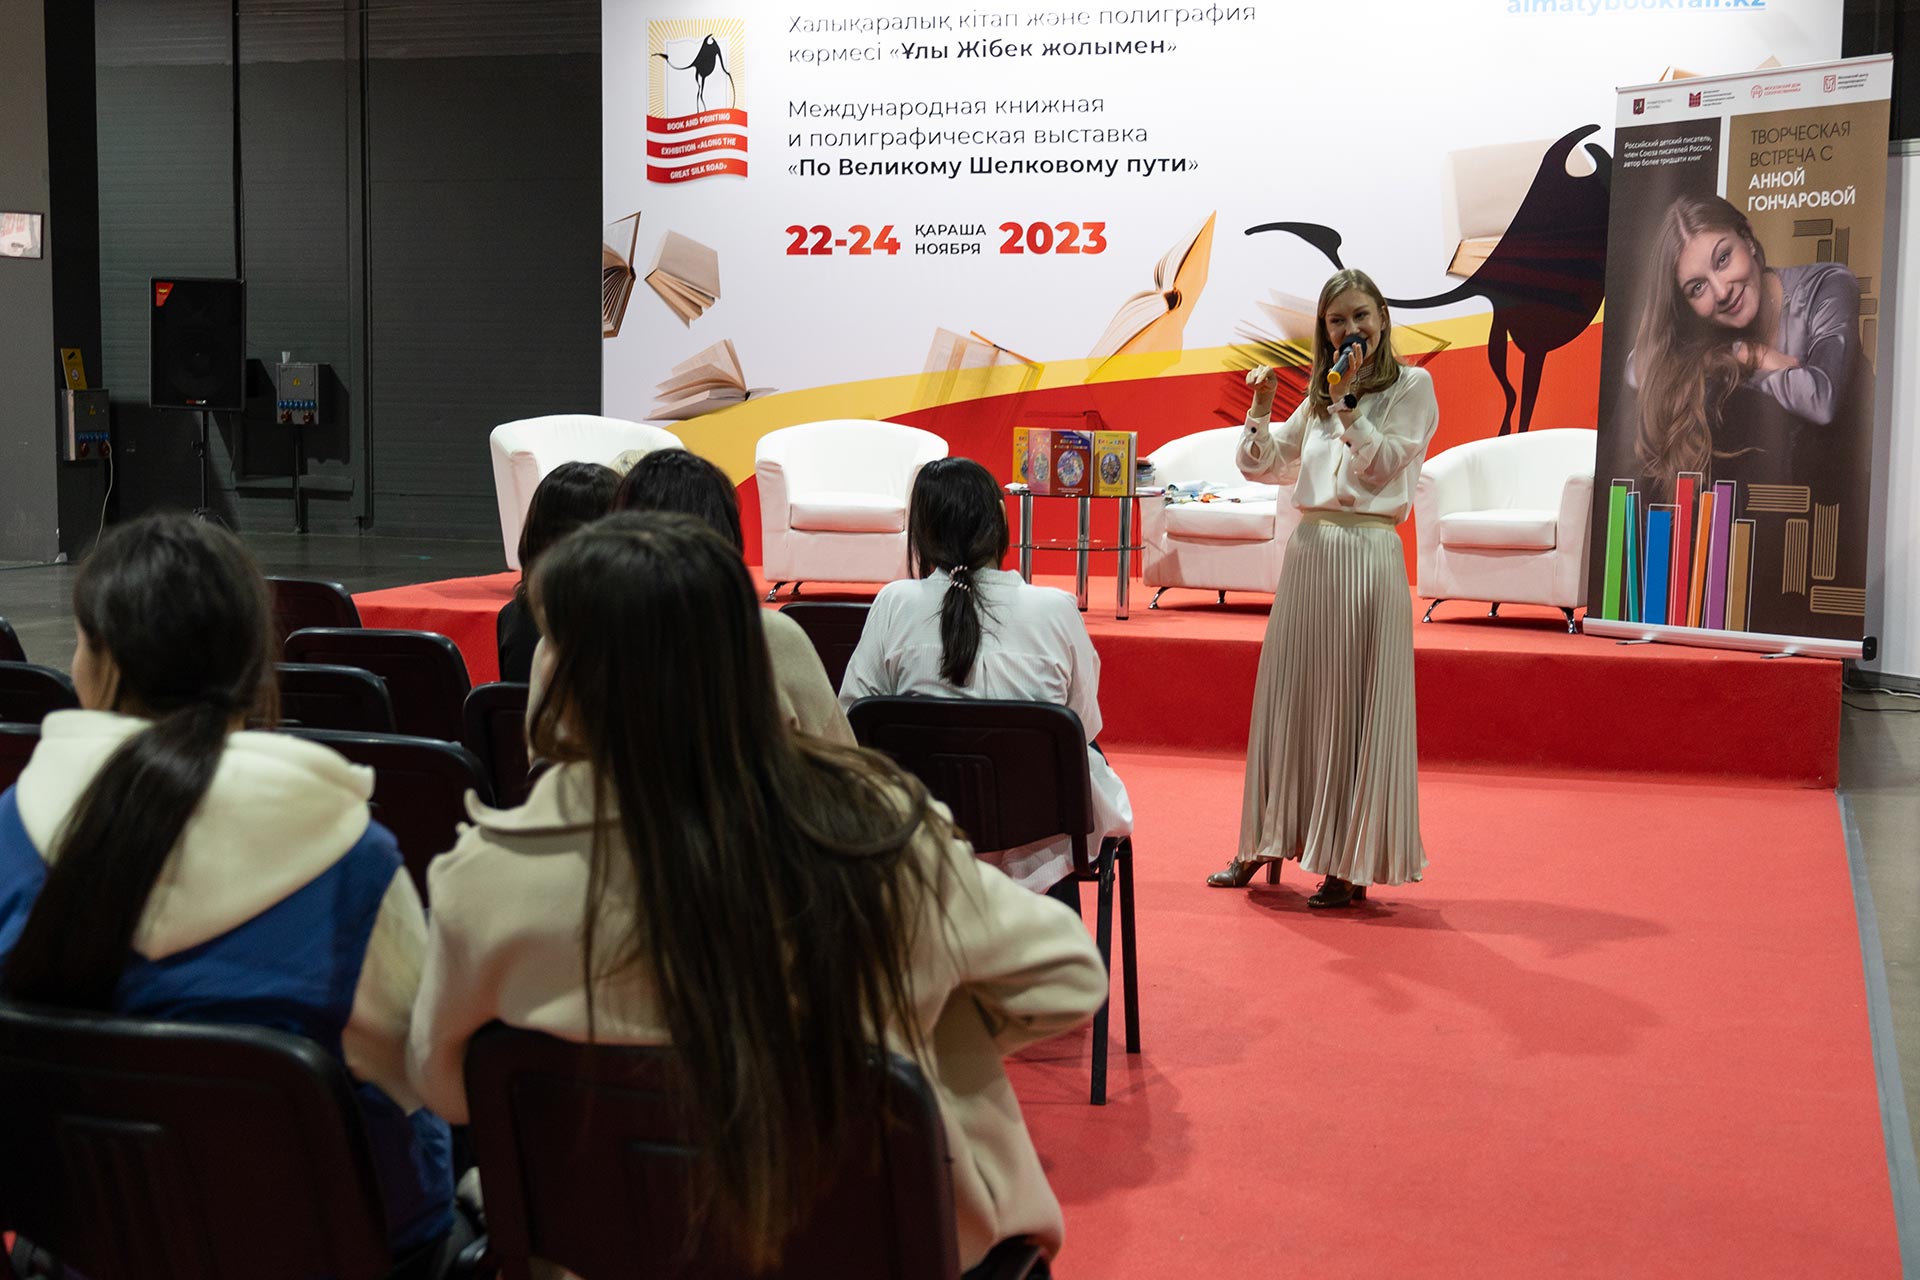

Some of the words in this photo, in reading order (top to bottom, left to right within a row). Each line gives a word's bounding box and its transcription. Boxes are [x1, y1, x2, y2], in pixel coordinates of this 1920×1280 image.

[789, 15, 952, 35] Халықаралық
[959, 9, 1018, 29] кітап
[1027, 11, 1090, 26] және
[1100, 3, 1256, 27] полиграфия
[789, 42, 881, 66] көрмесі
[890, 42, 948, 60] «Ұлы
[957, 38, 1033, 58] Жібек
[1041, 40, 1177, 56] жолымен»
[789, 100, 986, 121] Международная
[995, 98, 1104, 114] книжная
[667, 121, 684, 131] BOOK
[685, 118, 699, 127] AND
[699, 112, 731, 124] PRINTING
[1751, 120, 1850, 146] ТВОРЧЕСКАЯ
[661, 143, 696, 155] EXHIBITION
[722, 137, 737, 146] THE
[789, 133, 801, 147] и
[810, 127, 1025, 150] полиграфическая
[1034, 128, 1148, 144] выставка
[1624, 139, 1659, 150] Российский
[1659, 136, 1682, 147] детский
[1623, 160, 1641, 169] автор
[1641, 158, 1659, 167] более
[1660, 155, 1686, 166] тридцати
[1687, 154, 1702, 162] книг
[1624, 151, 1638, 159] член
[1639, 149, 1658, 158] Союза
[1658, 145, 1688, 156] писателей
[1750, 146, 1816, 168] ВСТРЕЧА
[1818, 145, 1834, 162] С
[670, 168, 690, 179] GREAT
[691, 165, 705, 176] SILK
[788, 158, 831, 176] «По
[839, 158, 962, 179] Великому
[970, 156, 1119, 178] Шелковому
[1127, 158, 1198, 177] пути»
[1748, 166, 1805, 190] АННОЙ
[1747, 186, 1856, 212] ГОНЧАРОВОЙ
[785, 224, 901, 256] 22-24
[915, 224, 987, 238] ҚАРАША
[998, 221, 1107, 255] 2023
[915, 242, 981, 255] НОЯБРЯ
